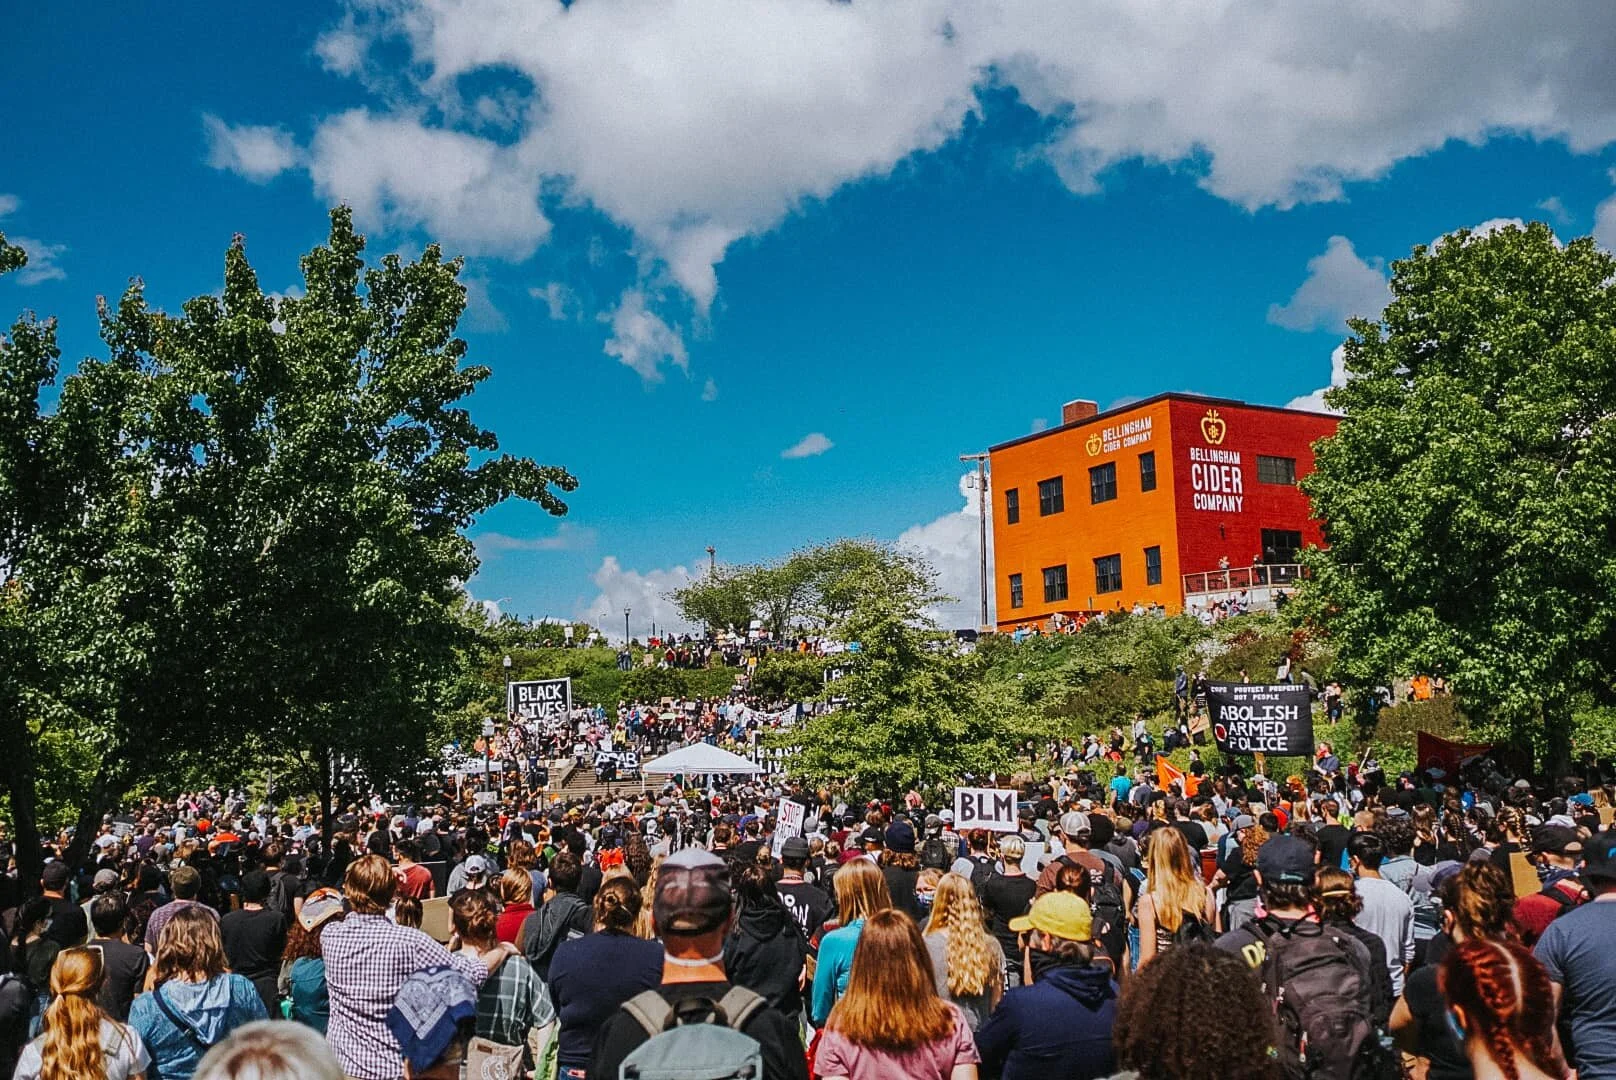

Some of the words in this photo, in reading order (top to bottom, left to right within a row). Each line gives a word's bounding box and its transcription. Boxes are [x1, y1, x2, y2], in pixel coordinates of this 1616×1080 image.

[1102, 416, 1152, 442] BELLINGHAM
[1103, 440, 1121, 453] CIDER
[1123, 430, 1152, 448] COMPANY
[1190, 447, 1240, 465] BELLINGHAM
[1191, 463, 1243, 494] CIDER
[1193, 493, 1243, 512] COMPANY
[518, 683, 562, 702] BLACK
[1220, 704, 1299, 721] ABOLISH
[1228, 721, 1287, 737] ARMED
[1229, 736, 1289, 752] POLICE
[760, 760, 787, 774] LIV
[782, 802, 802, 823] STOP
[960, 792, 1013, 822] BLM
